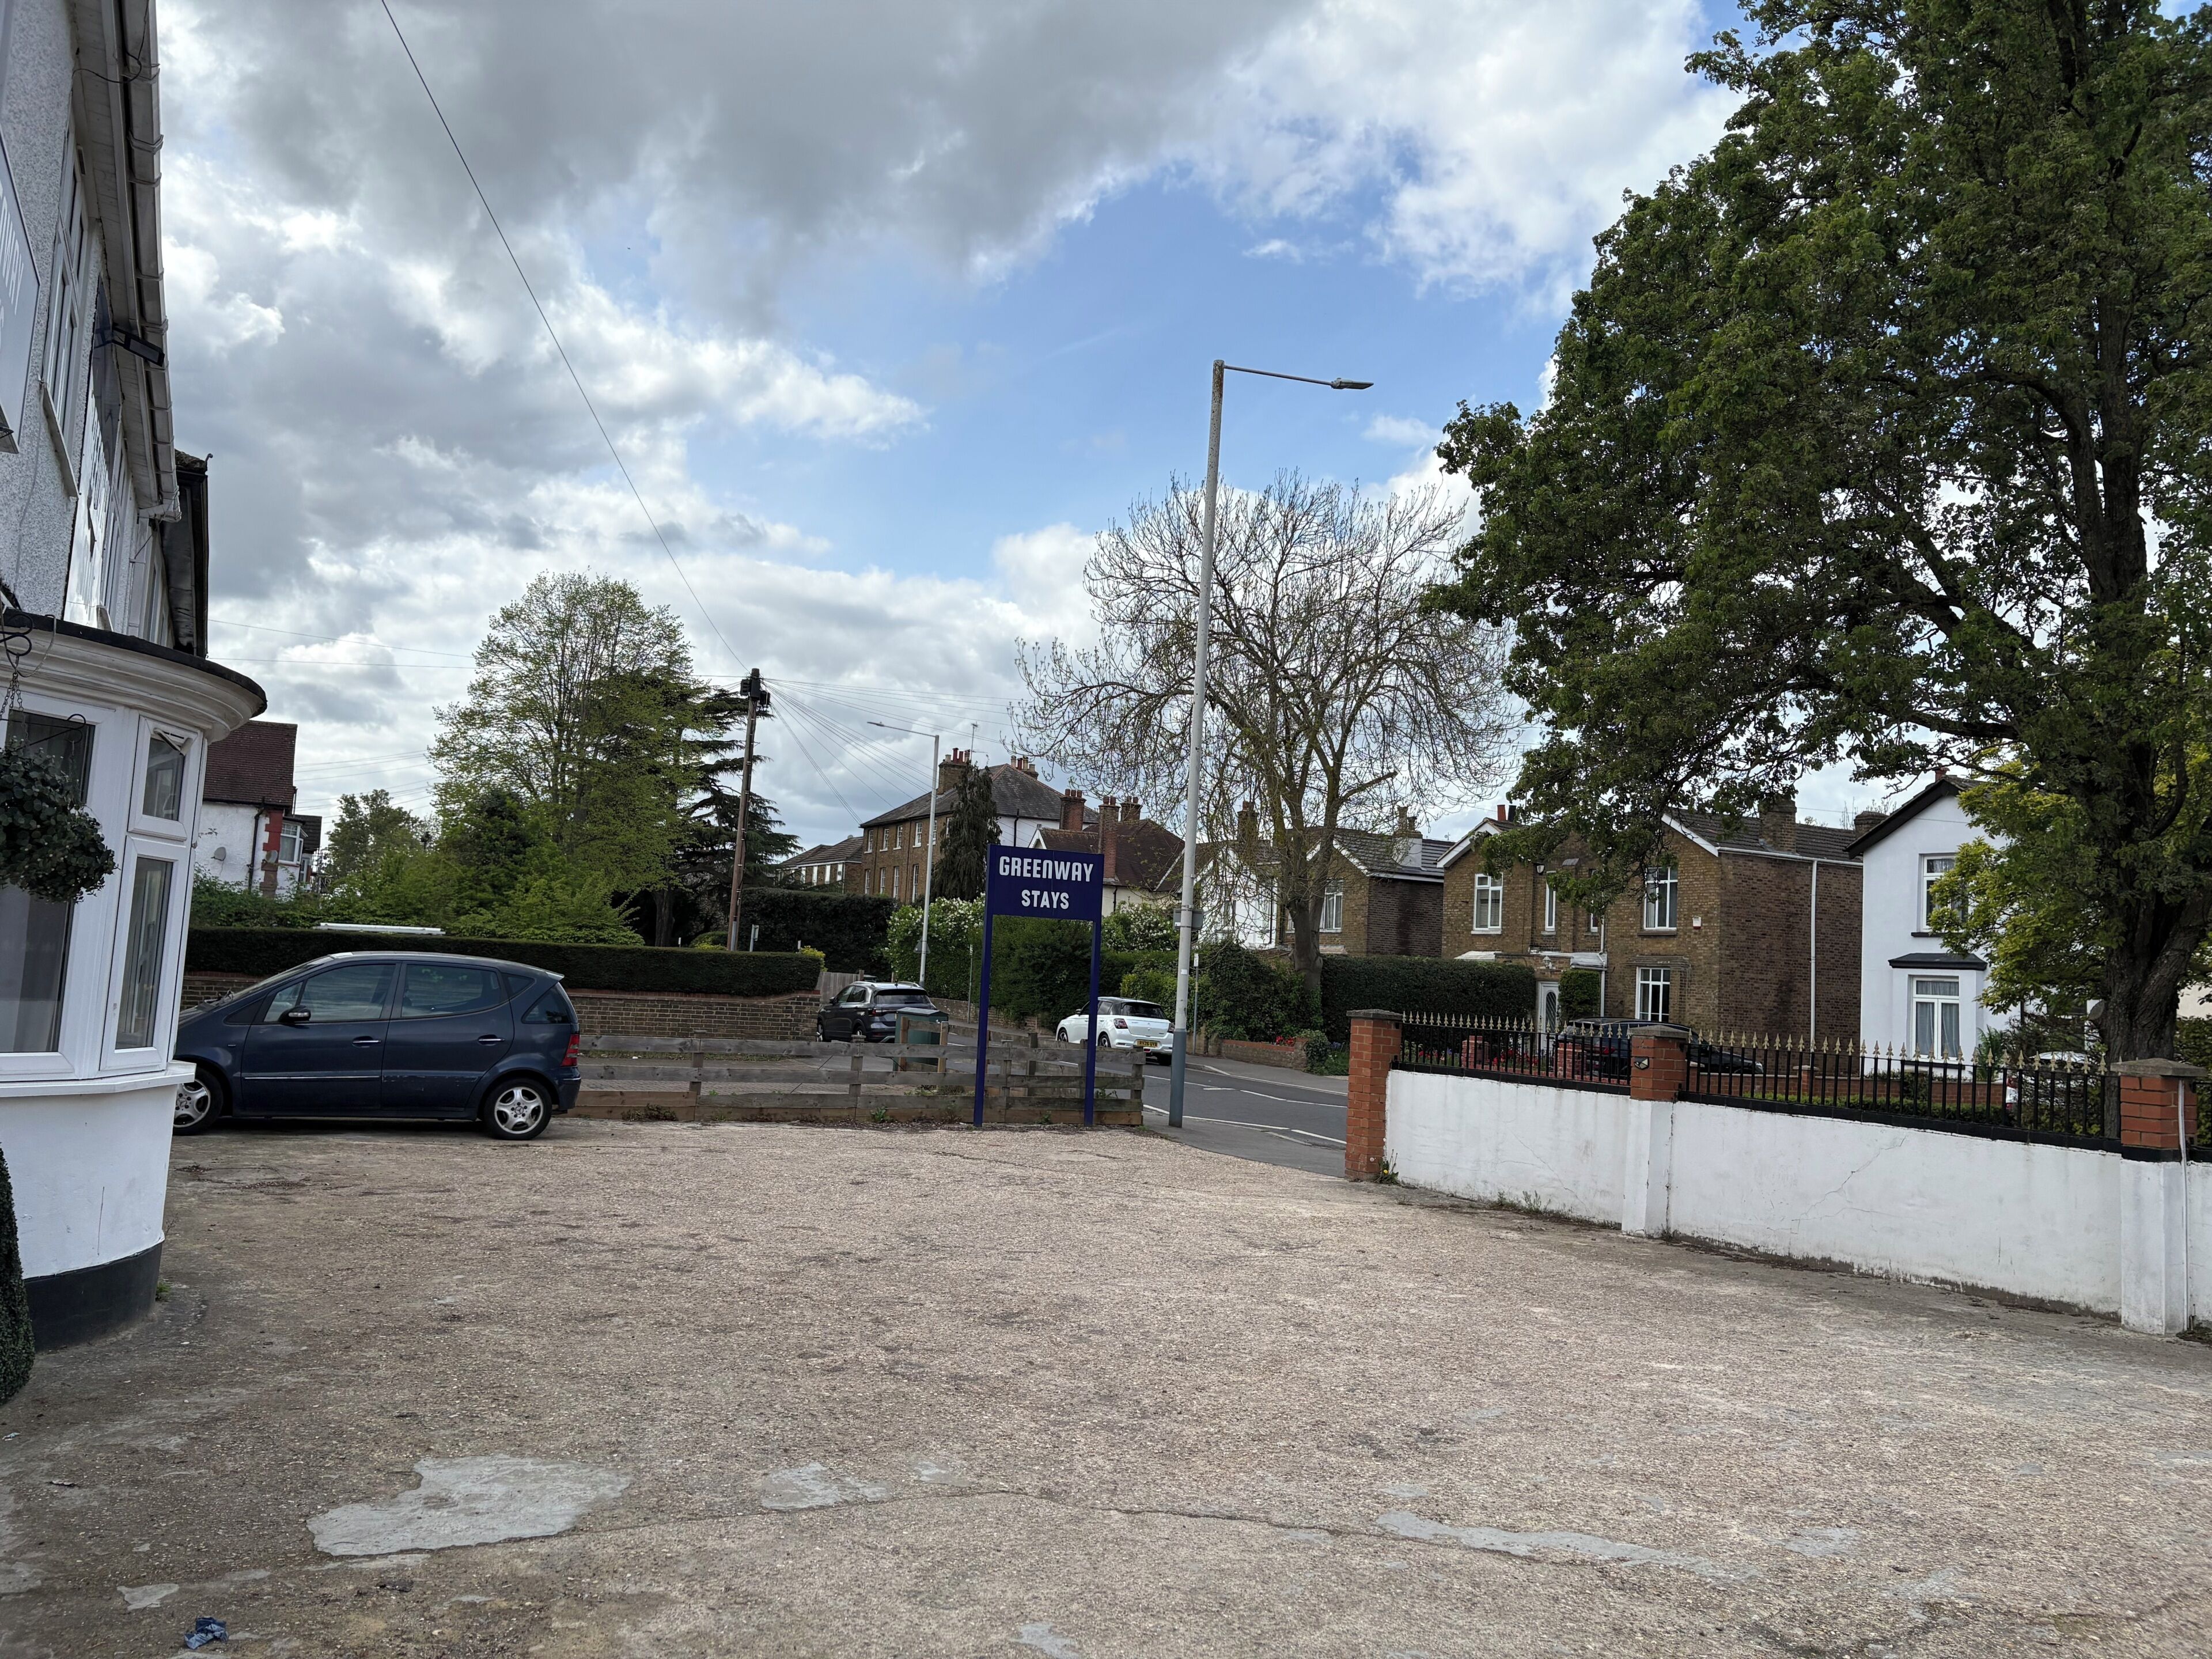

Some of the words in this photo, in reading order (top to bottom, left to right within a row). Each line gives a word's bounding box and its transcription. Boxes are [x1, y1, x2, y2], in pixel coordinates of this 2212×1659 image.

[0, 180, 24, 316] NWAY
[999, 855, 1093, 882] GREENWAY
[1021, 889, 1069, 910] STAYS
